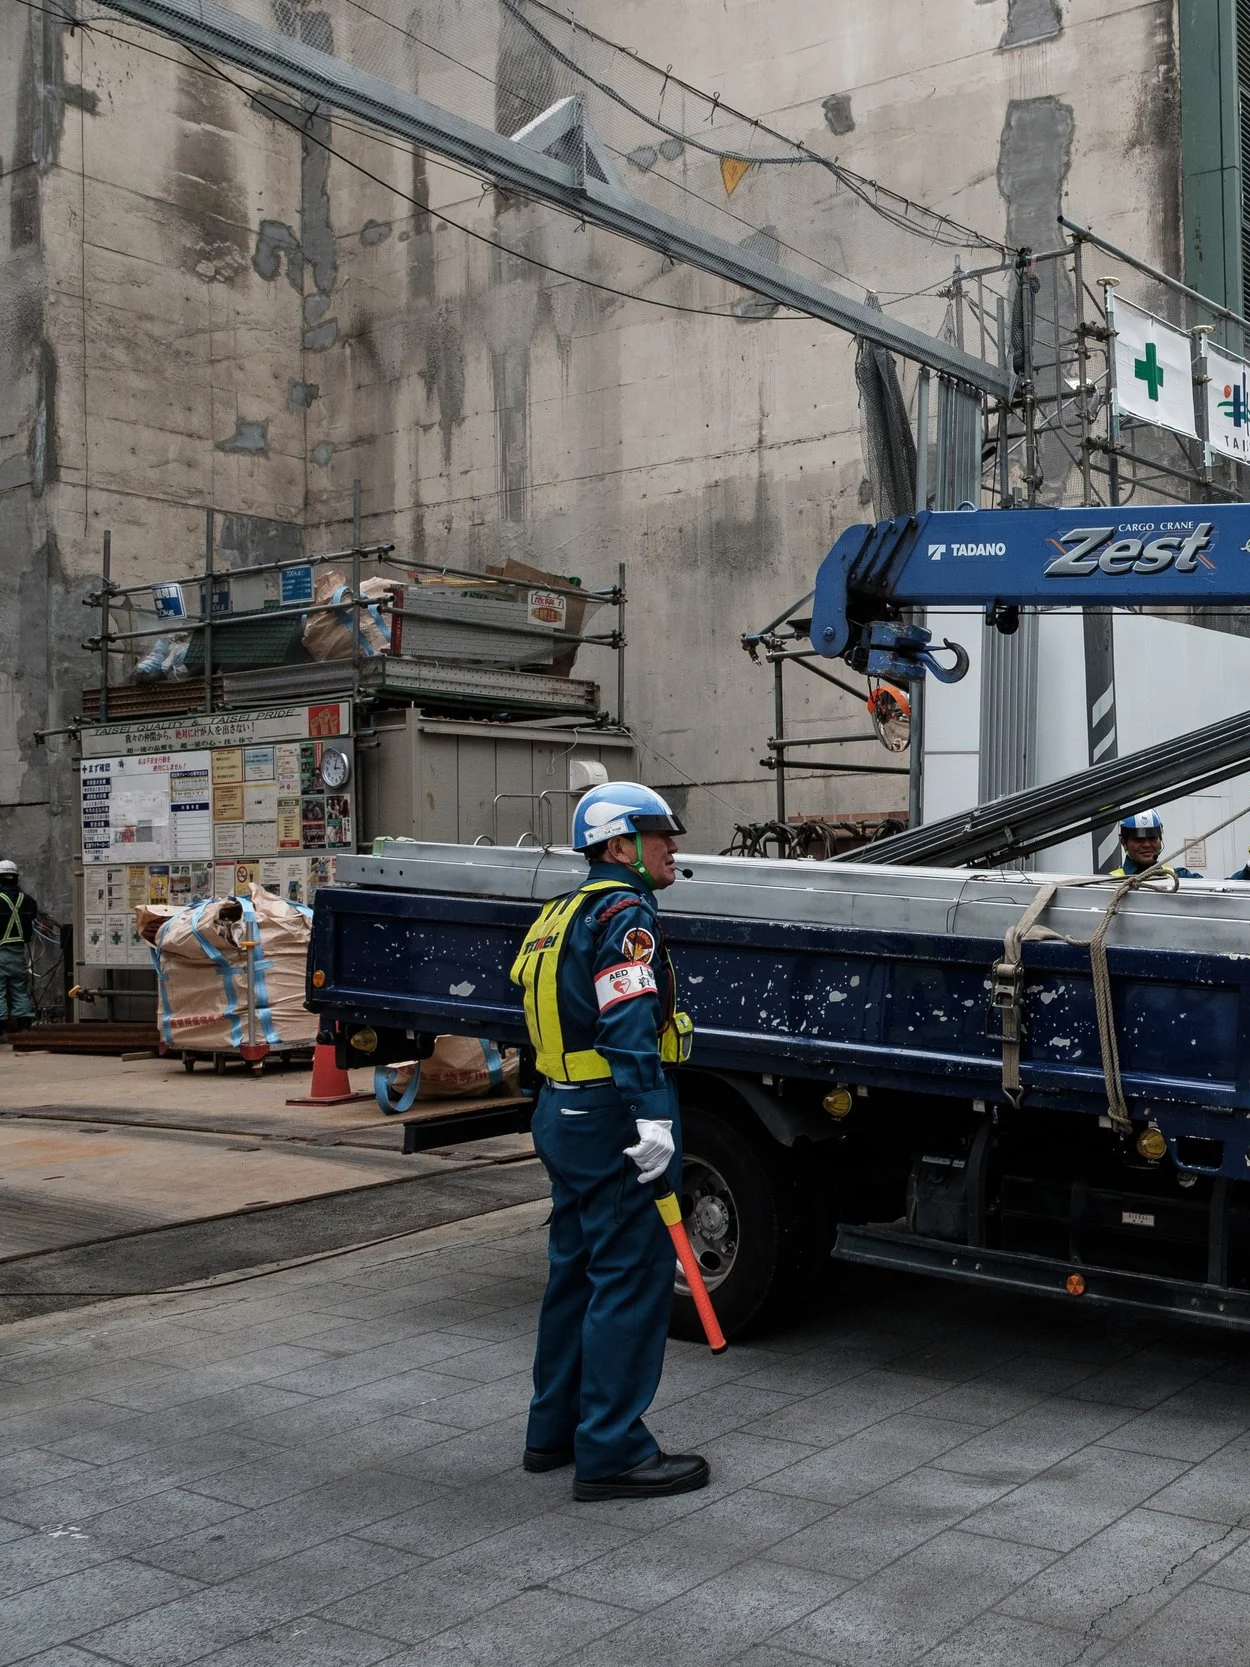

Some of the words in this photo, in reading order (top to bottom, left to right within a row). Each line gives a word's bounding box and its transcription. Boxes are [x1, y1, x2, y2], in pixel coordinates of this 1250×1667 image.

[1118, 522, 1155, 532] CARGO
[1160, 521, 1194, 530] CRANE
[951, 543, 1006, 556] TADANO
[1044, 522, 1213, 577] Zest
[94, 727, 132, 736] TAISEI
[137, 720, 185, 731] QUALITY
[209, 714, 253, 724] TAISEI
[257, 708, 296, 719] PRIDE
[609, 969, 629, 981] AED
